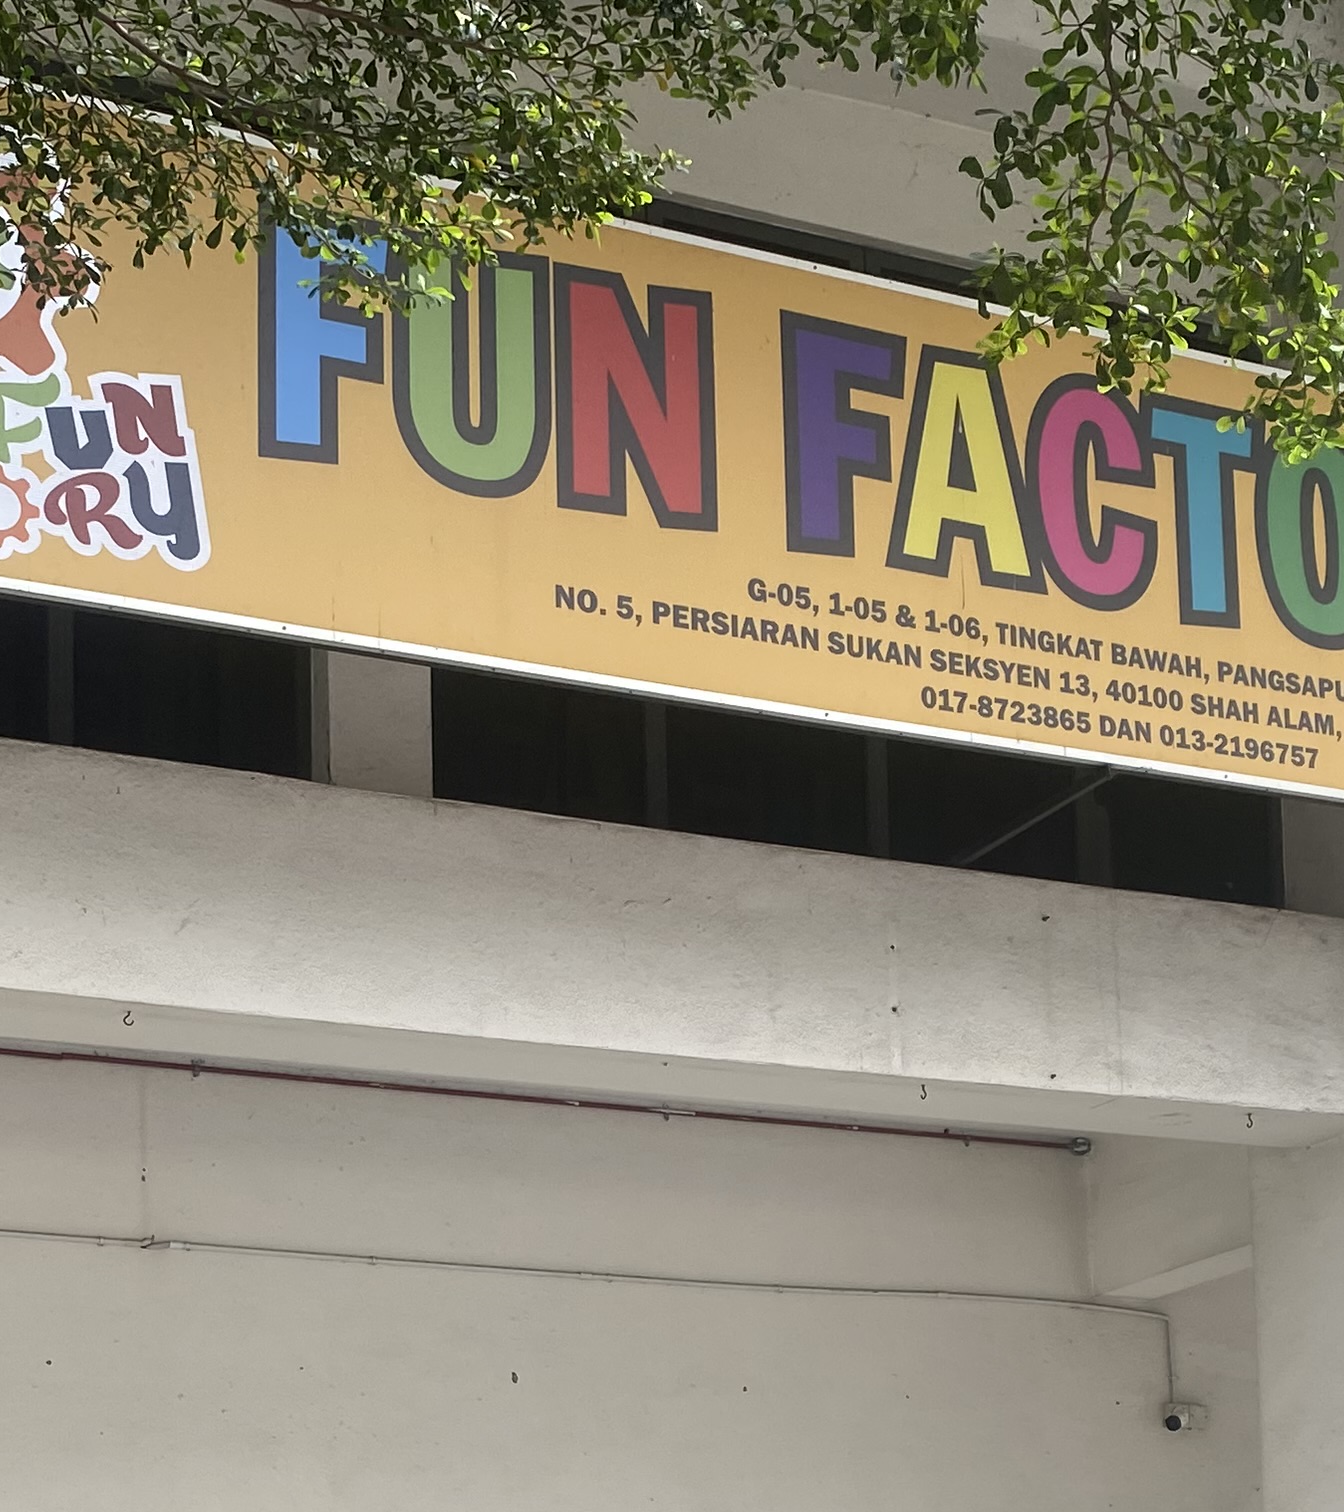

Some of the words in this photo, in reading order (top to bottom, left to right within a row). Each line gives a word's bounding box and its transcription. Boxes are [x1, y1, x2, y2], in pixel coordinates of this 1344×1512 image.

[258, 210, 718, 532] FUN
[555, 584, 607, 615] NO.
[616, 595, 642, 627] 5,
[652, 600, 820, 651] PERSIARAN
[827, 631, 922, 669] SUKAN
[930, 649, 1051, 690] SEKSYEN
[1059, 671, 1099, 703] 13,
[1105, 679, 1184, 712] 40100
[1190, 693, 1258, 724] SHAH
[1266, 705, 1343, 742] ALAM,
[748, 578, 819, 616] G-05,
[829, 592, 887, 623] 1-05
[895, 604, 916, 628] &
[925, 609, 989, 647] 1-06,
[995, 621, 1104, 662] TINGKAT
[1111, 643, 1210, 685] BAWAH,
[921, 685, 1091, 733] 017-8723865
[1099, 714, 1152, 743] DAN
[1159, 724, 1319, 770] 013-2196757
